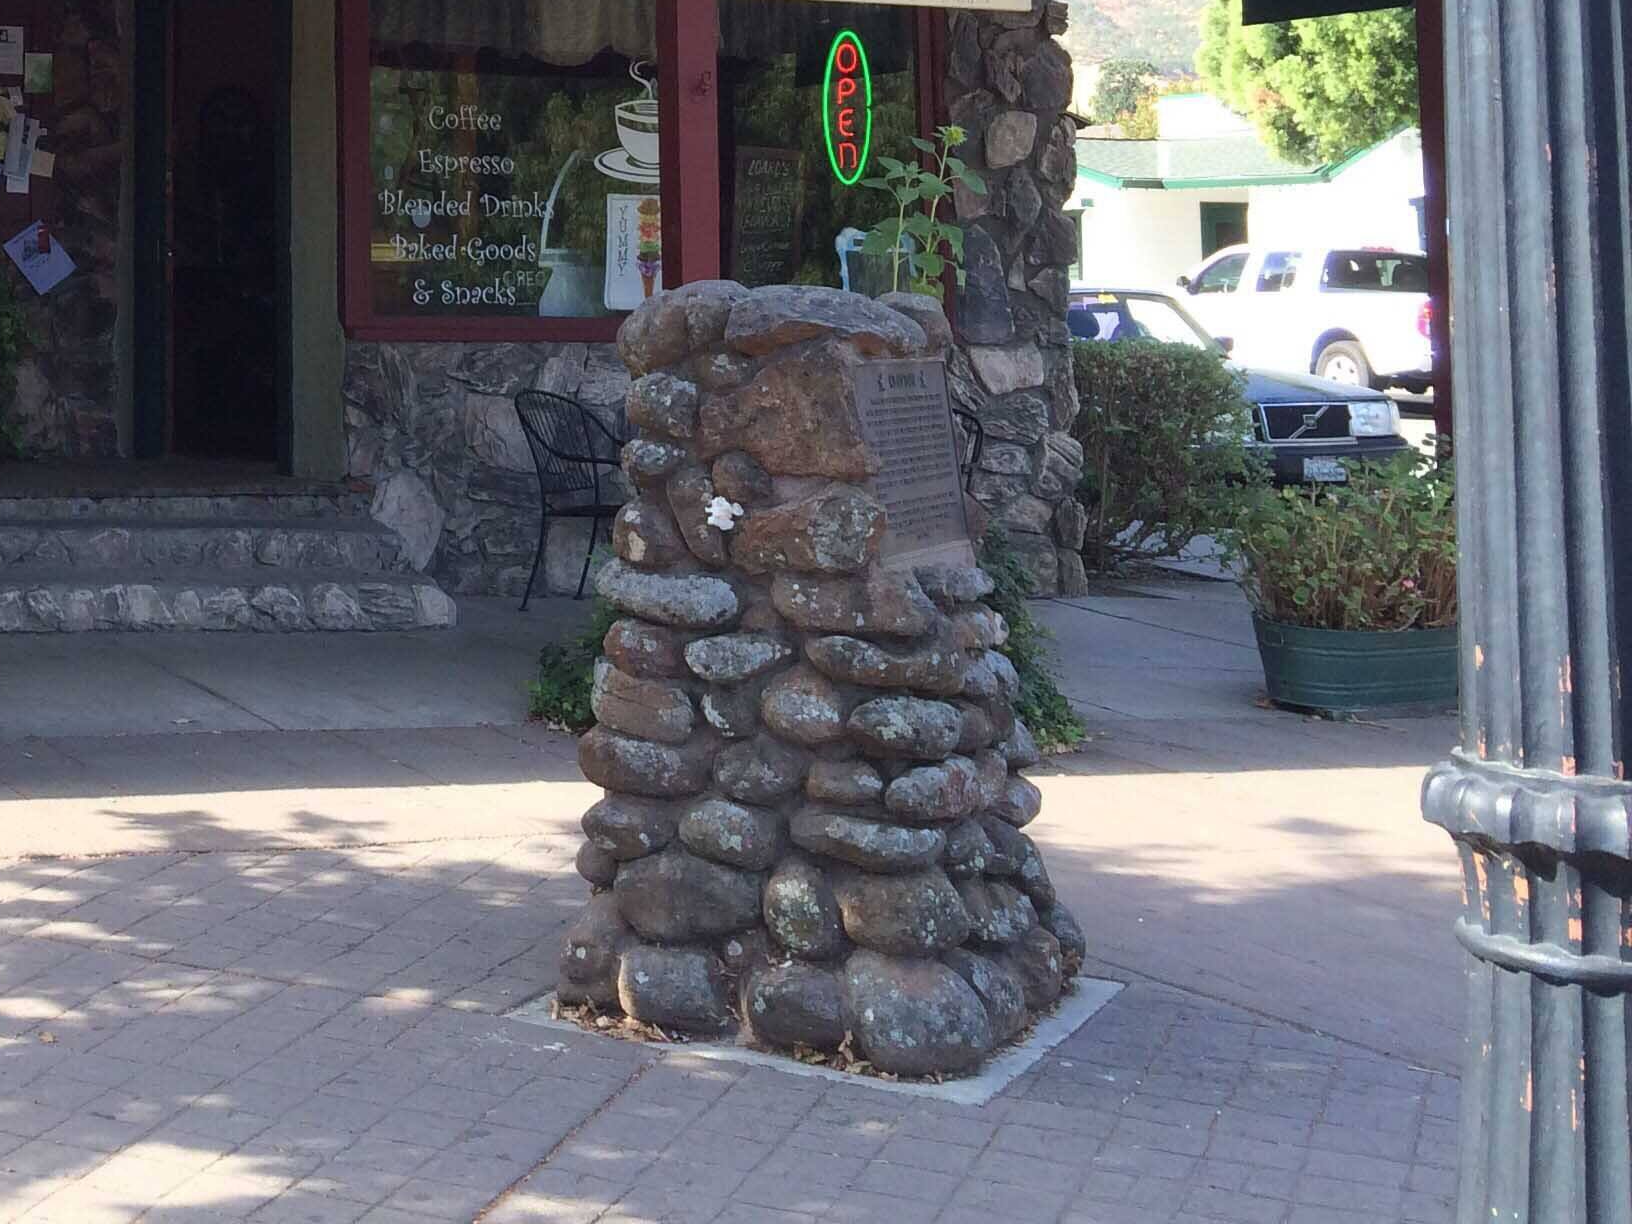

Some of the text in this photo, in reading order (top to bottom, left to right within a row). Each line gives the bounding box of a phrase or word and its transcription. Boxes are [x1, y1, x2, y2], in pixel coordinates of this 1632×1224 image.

[428, 104, 502, 132] Coffee
[834, 42, 858, 169] OPEN
[418, 148, 515, 179] Espresso
[378, 189, 555, 220] Blended Drinks
[390, 232, 537, 266] Baked Goods
[616, 204, 629, 277] YUMMY
[412, 278, 517, 307] & Snacks
